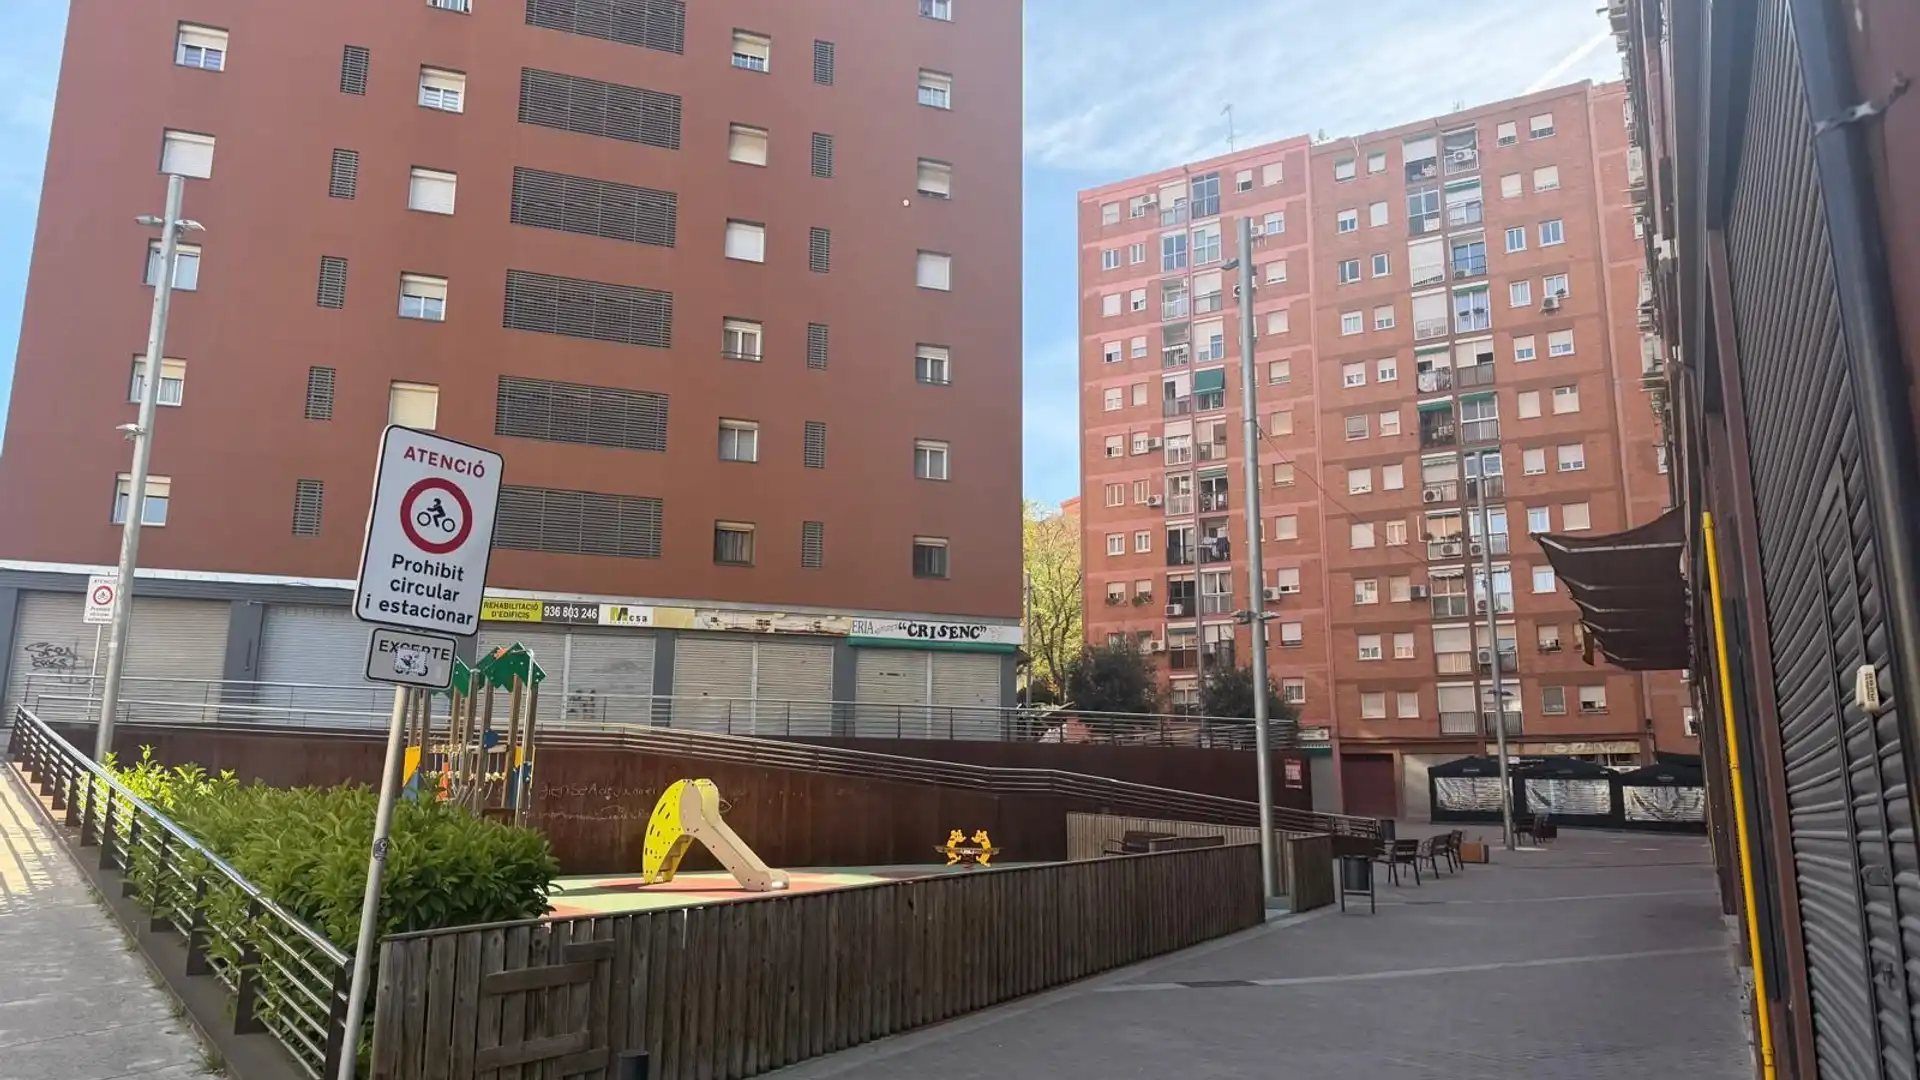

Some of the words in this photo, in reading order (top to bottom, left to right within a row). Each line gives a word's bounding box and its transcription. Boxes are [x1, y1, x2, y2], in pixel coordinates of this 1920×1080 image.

[403, 446, 485, 478] ATENCIÓ
[391, 553, 464, 581] Prohibit
[390, 577, 460, 602] circular
[365, 593, 371, 609] i
[378, 600, 474, 625] estacionar
[543, 606, 561, 616] 936
[562, 607, 579, 618] 803
[581, 608, 598, 619] 246
